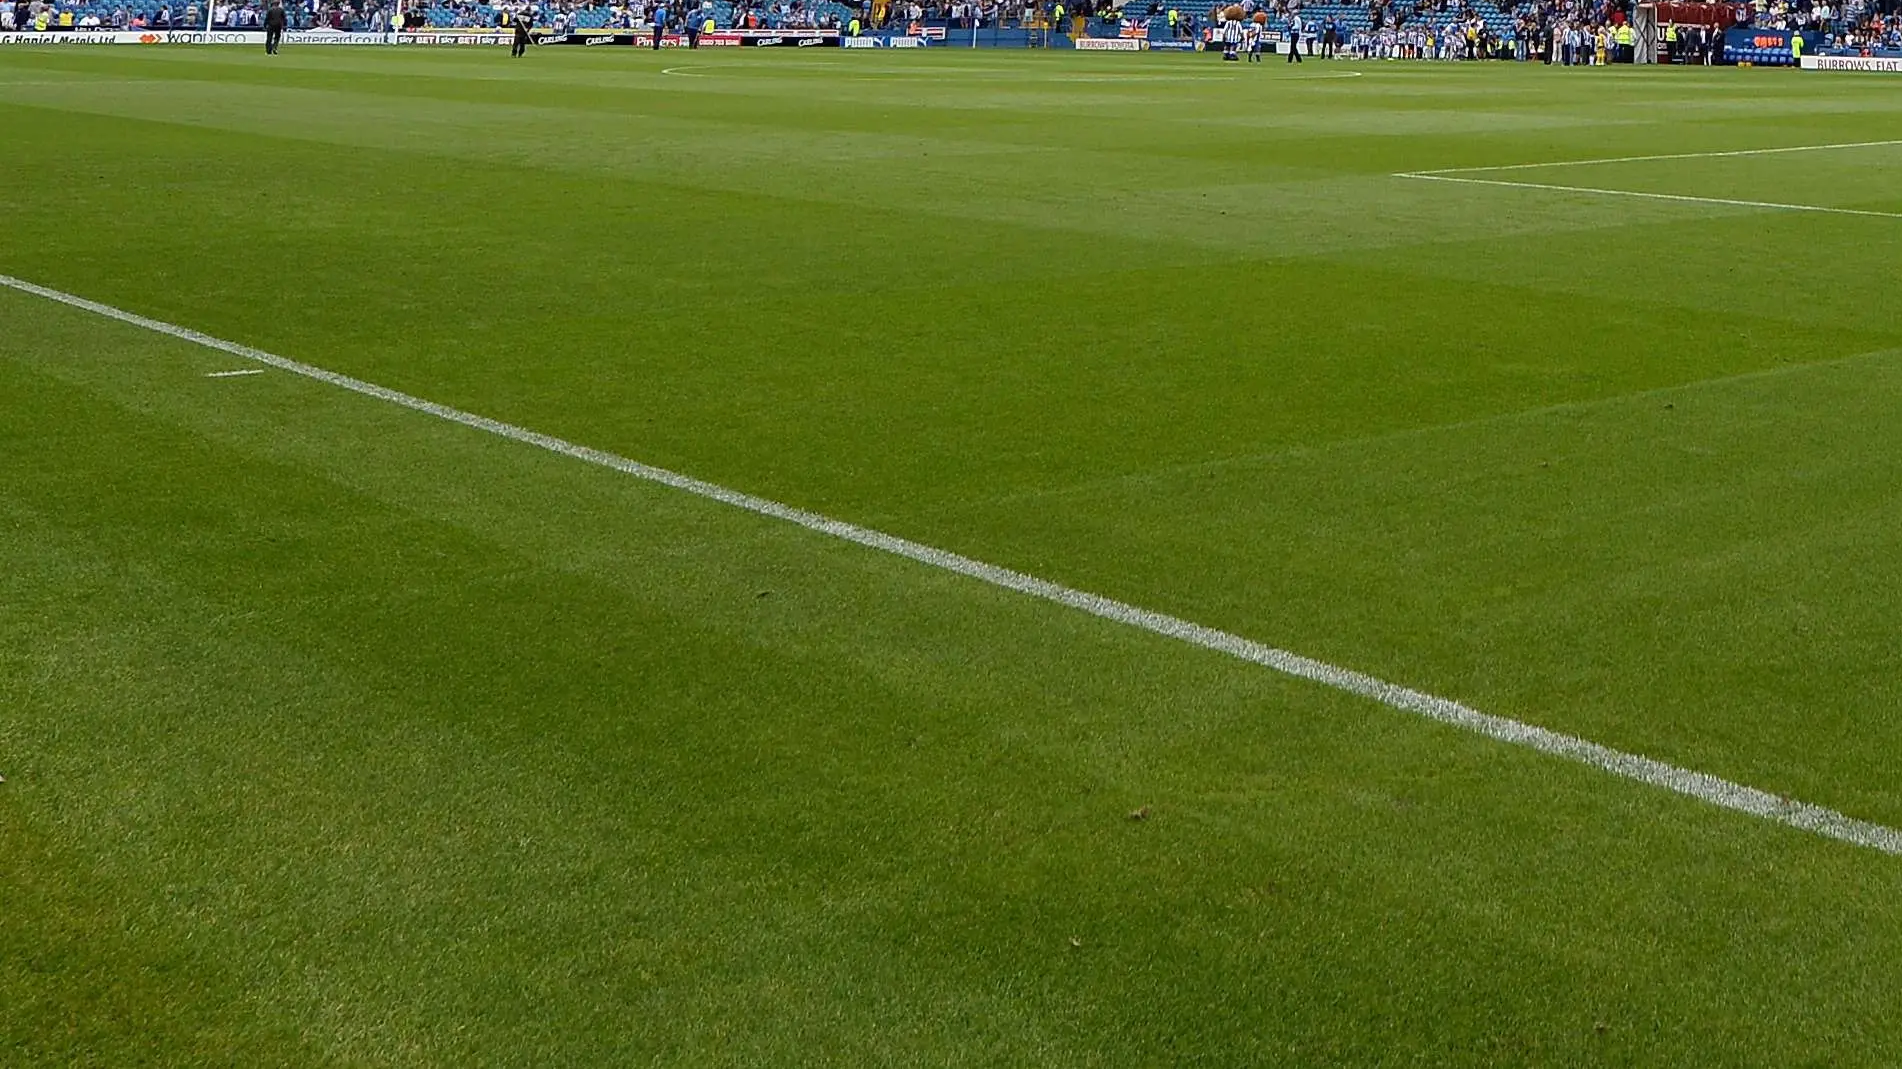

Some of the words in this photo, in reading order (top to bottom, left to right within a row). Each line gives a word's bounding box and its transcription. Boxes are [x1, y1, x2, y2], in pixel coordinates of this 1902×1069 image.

[636, 36, 677, 47] Piners
[844, 37, 874, 48] PUMA
[890, 38, 918, 48] PUMA
[1817, 59, 1871, 72] BURROWS
[1876, 61, 1898, 72] FIAT
